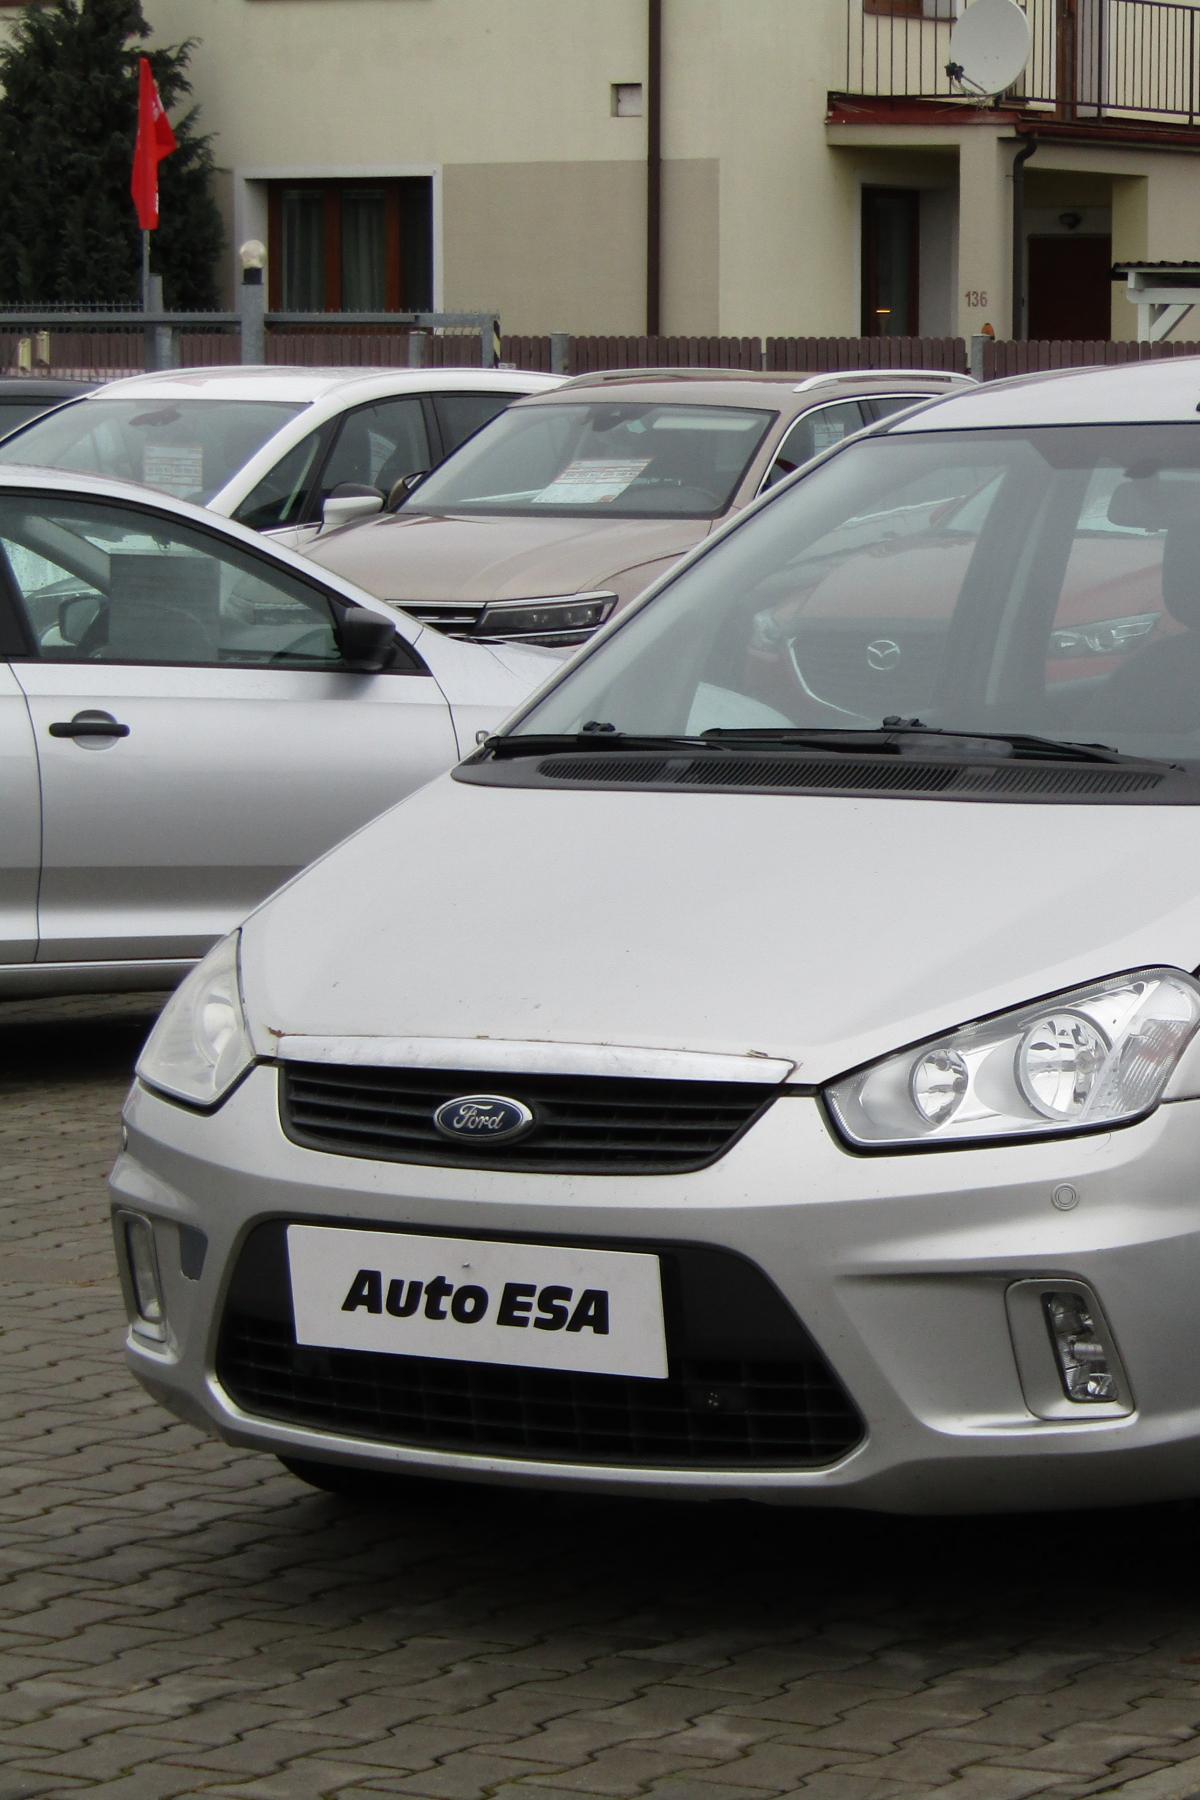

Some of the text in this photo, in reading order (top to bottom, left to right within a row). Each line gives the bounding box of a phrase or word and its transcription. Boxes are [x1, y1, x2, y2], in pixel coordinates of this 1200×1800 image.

[965, 290, 988, 308] 136
[453, 1103, 506, 1130] Ford
[341, 1269, 611, 1336] Auto ESA
